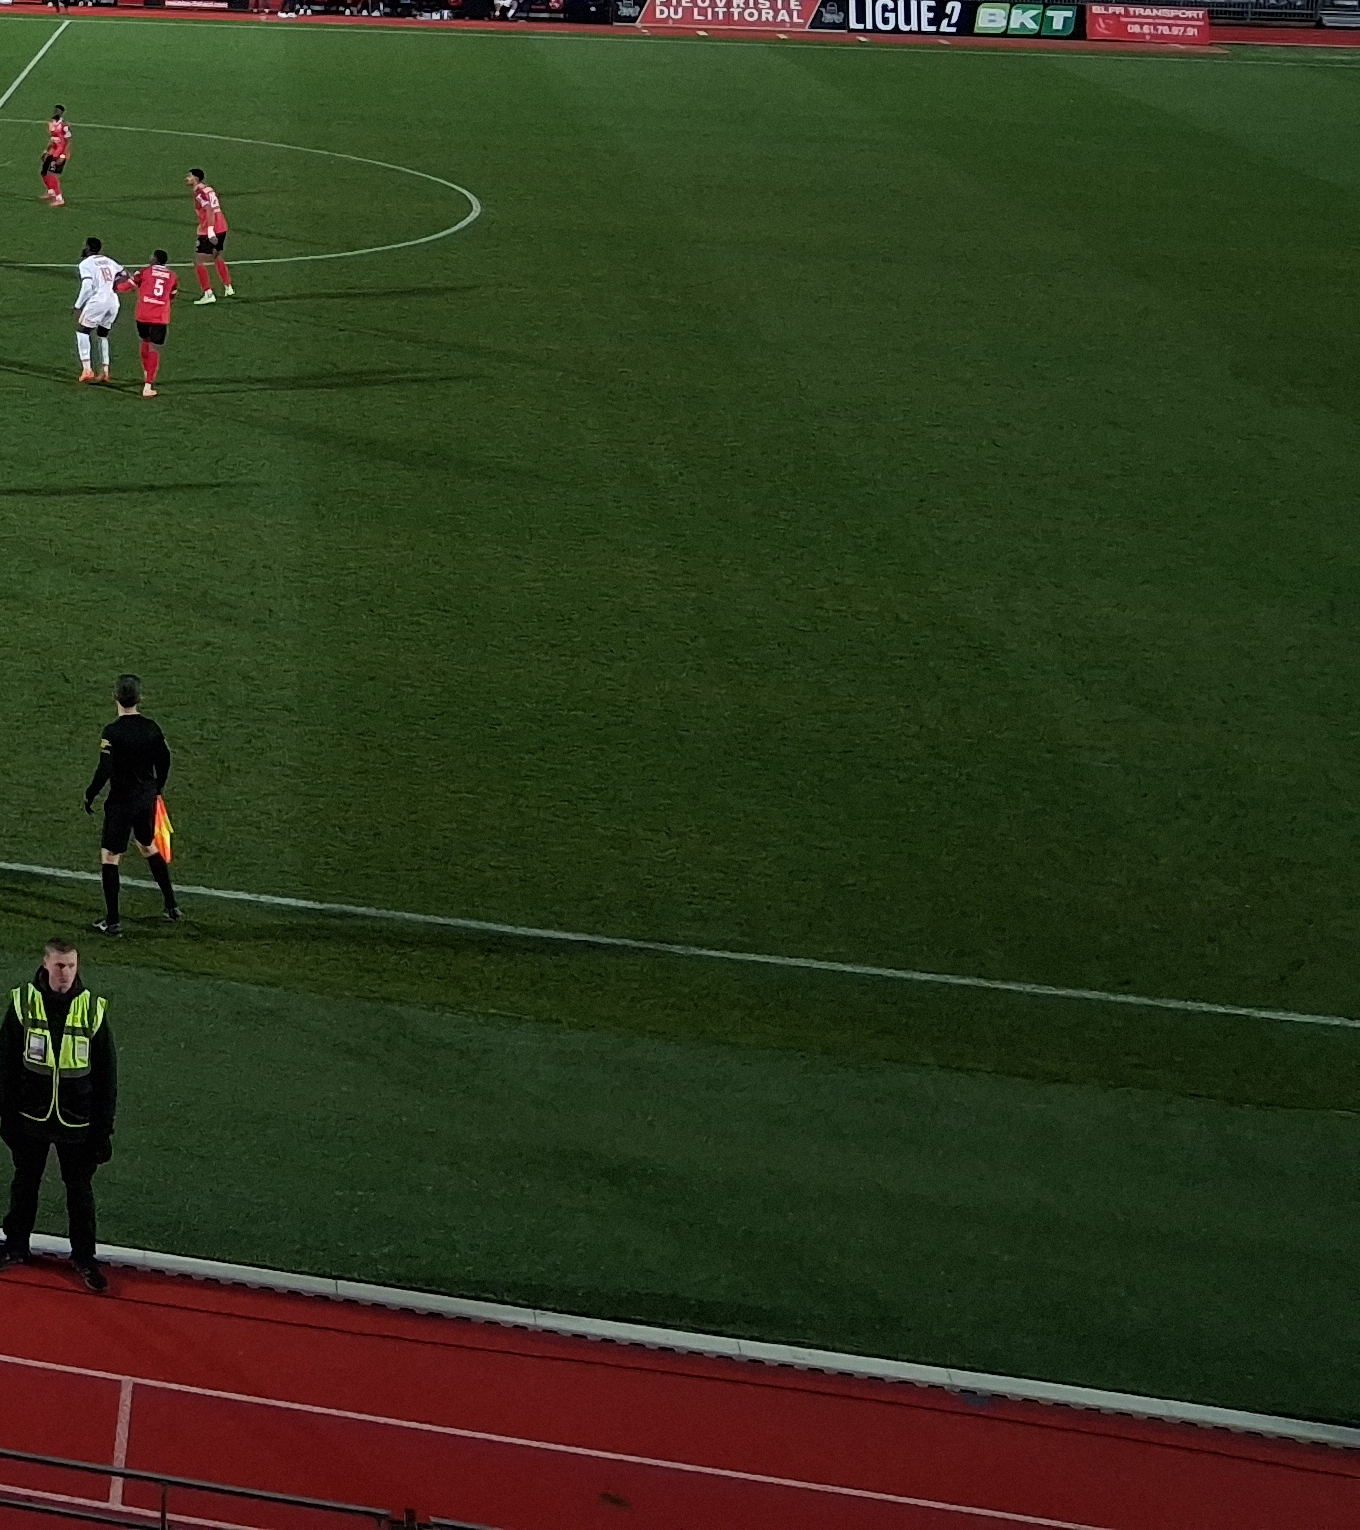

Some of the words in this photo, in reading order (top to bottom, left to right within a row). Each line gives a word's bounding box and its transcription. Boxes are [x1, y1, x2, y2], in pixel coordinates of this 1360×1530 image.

[655, 6, 682, 19] DU
[693, 7, 804, 23] LITTORAL
[939, 0, 962, 32] 2
[977, 5, 1076, 34] BKT
[1128, 7, 1205, 19] TRANSPORT
[154, 278, 164, 297] 5
